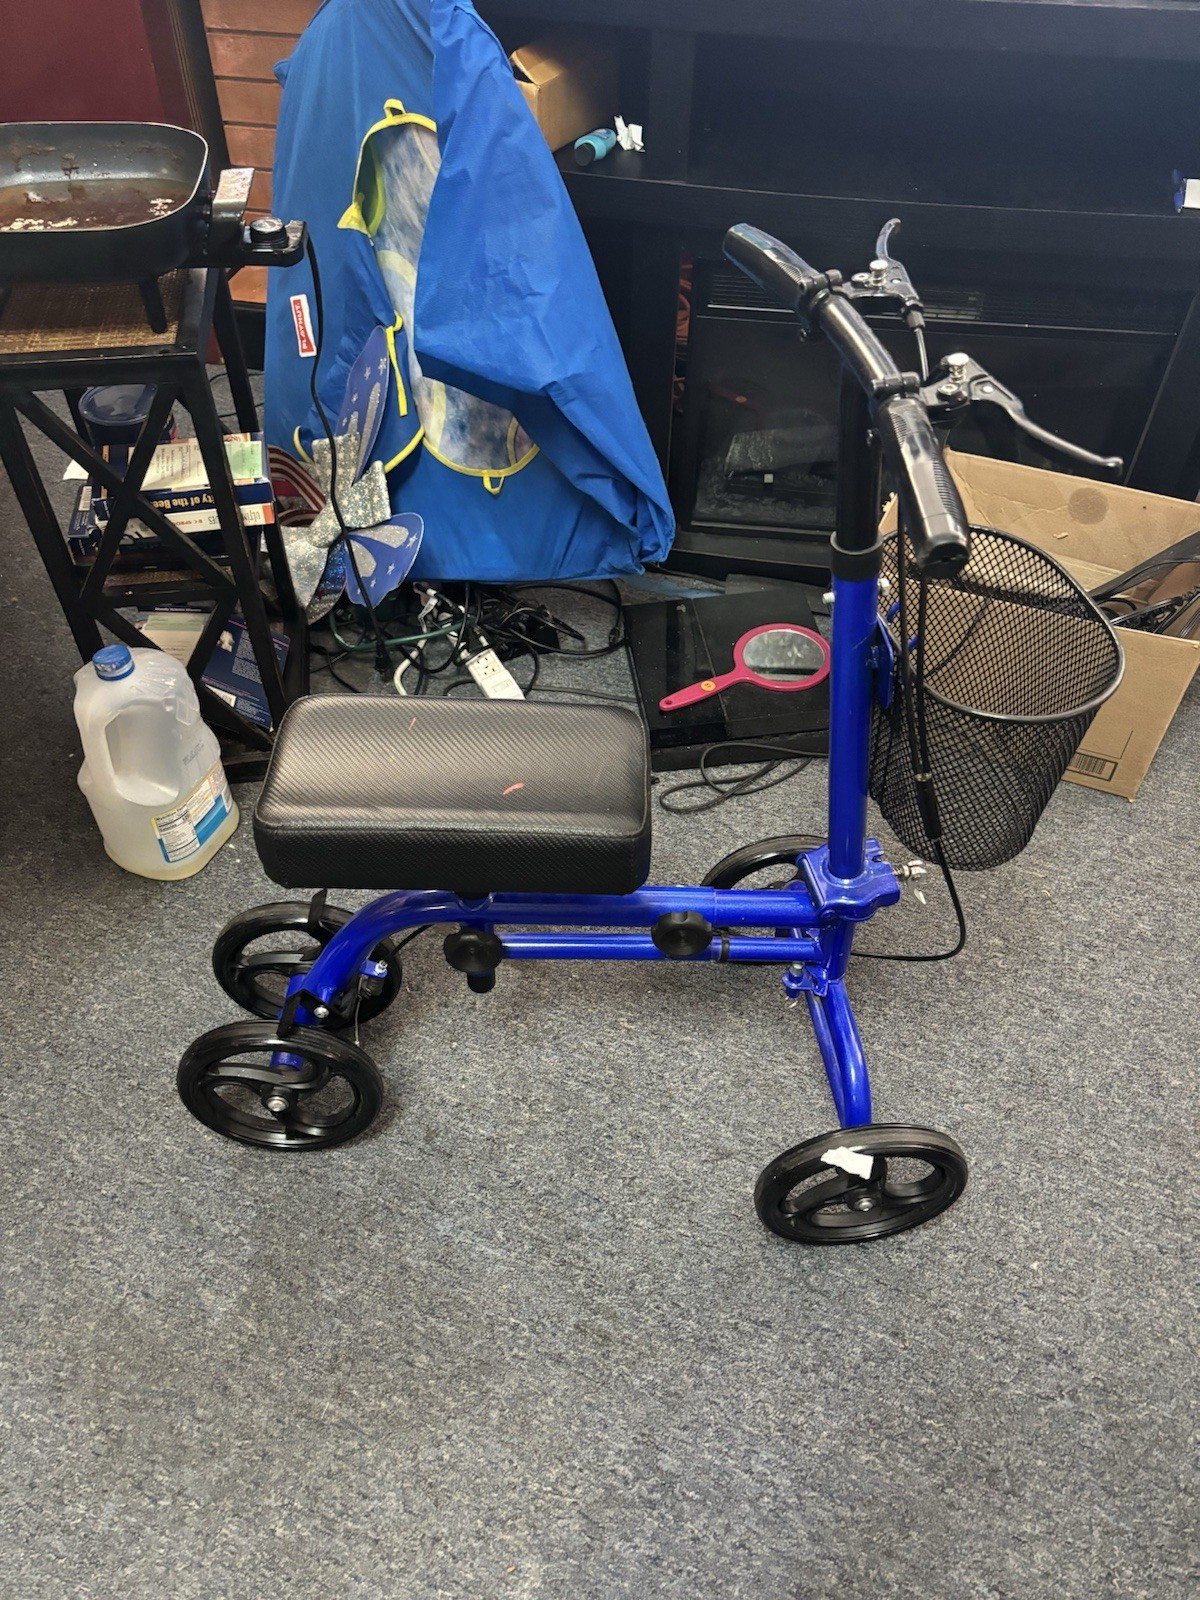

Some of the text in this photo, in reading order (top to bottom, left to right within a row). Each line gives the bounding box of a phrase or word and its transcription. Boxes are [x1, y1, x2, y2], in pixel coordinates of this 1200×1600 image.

[151, 499, 171, 509] Bee
[172, 499, 190, 508] the
[190, 497, 200, 507] of
